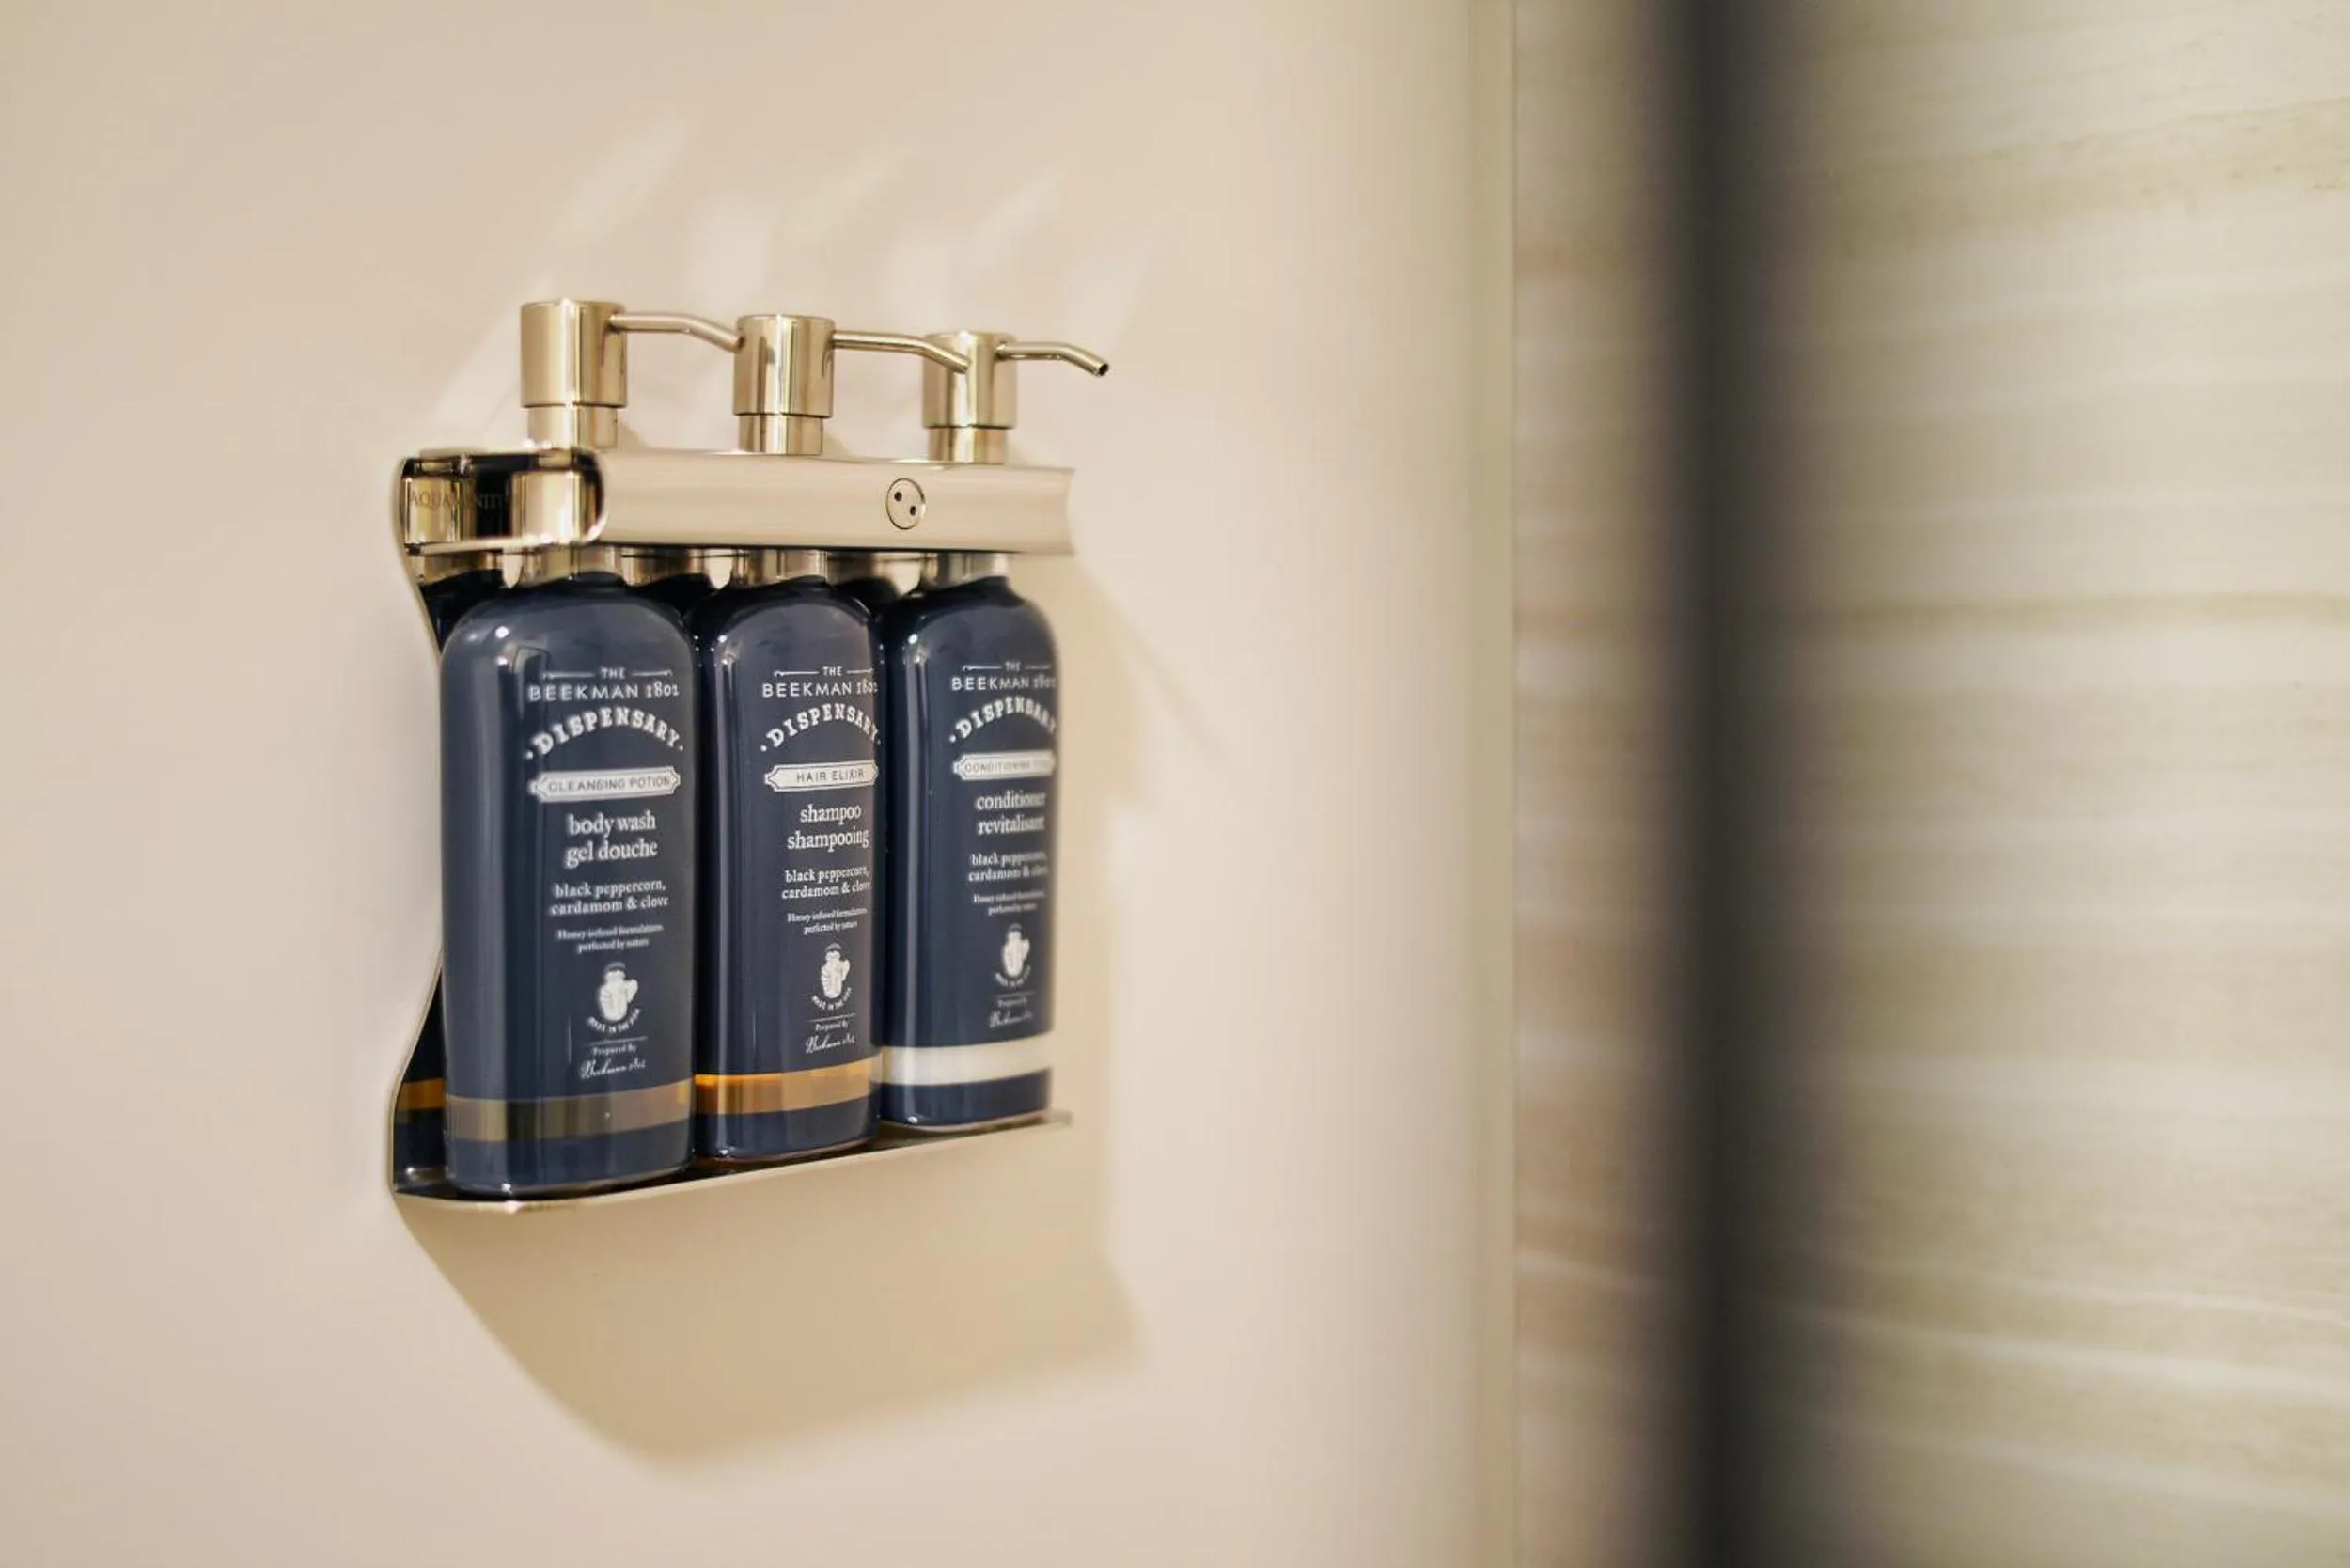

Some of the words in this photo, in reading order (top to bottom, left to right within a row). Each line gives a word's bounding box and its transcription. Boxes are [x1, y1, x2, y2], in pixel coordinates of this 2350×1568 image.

[600, 667, 626, 679] THE
[822, 666, 843, 676] THE
[1005, 661, 1021, 672] THE
[527, 684, 639, 701] BEEKMAN
[646, 681, 680, 698] 1802
[762, 682, 852, 698] BEEKMAN
[951, 677, 1029, 691] BEEKMAN
[531, 706, 680, 755] DISPENSARY
[766, 703, 878, 747] DISPENSARY
[548, 778, 624, 792] CLEANSING
[629, 776, 670, 789] POTION
[796, 772, 827, 783] HAIR
[832, 769, 865, 781] ELIXIR
[976, 790, 1045, 809] conditioner
[566, 812, 614, 839] body
[617, 809, 656, 831] wash
[800, 804, 862, 825] shampoo
[977, 813, 1045, 835] revitalisant
[787, 825, 869, 852] shampooing
[564, 840, 593, 869] gel
[598, 838, 658, 861] douche
[970, 852, 998, 866] black
[785, 868, 816, 883] black
[554, 882, 592, 898] black
[595, 879, 666, 900] peppercorn,
[781, 885, 839, 899] cardamom
[841, 882, 850, 894] &
[550, 900, 623, 916] cardamom
[626, 896, 637, 910] &
[640, 895, 669, 908] clove
